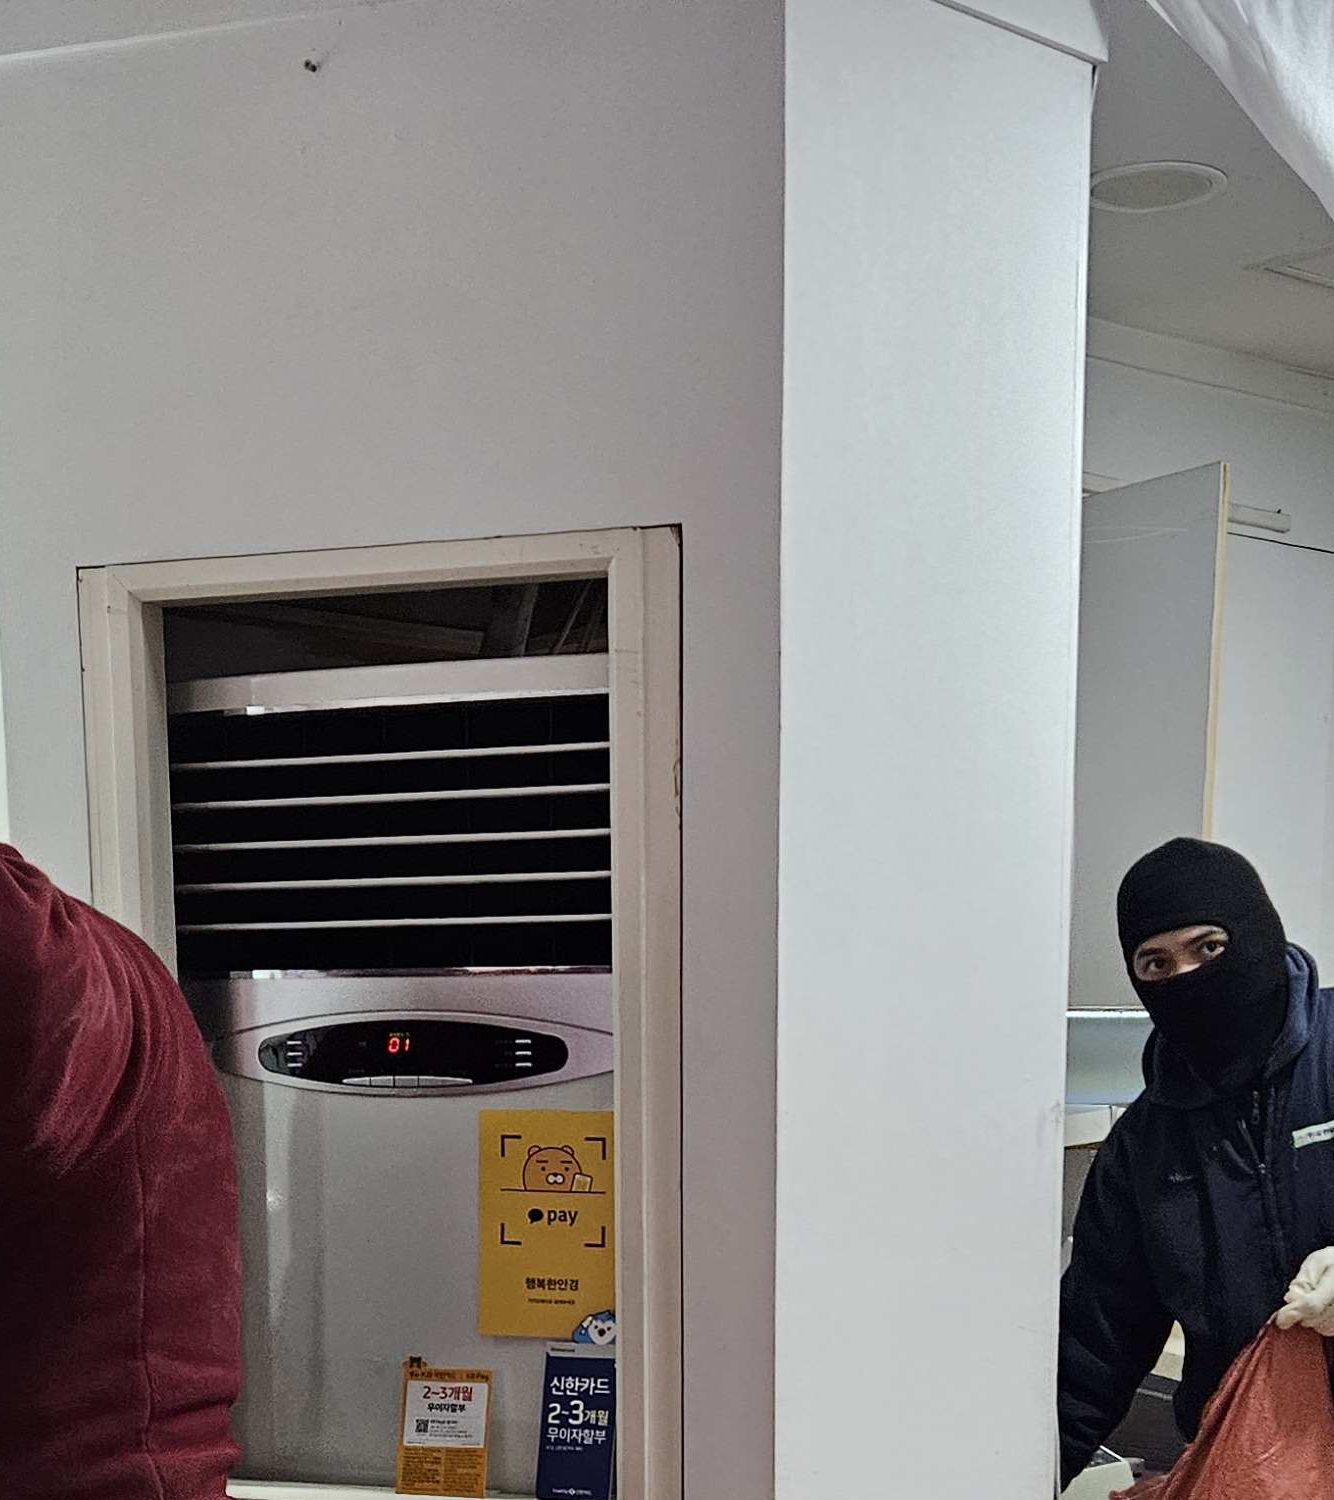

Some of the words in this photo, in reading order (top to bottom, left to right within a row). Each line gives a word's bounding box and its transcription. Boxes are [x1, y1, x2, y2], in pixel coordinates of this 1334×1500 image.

[388, 1037, 410, 1054] 01
[547, 1210, 578, 1227] pay
[550, 1376, 610, 1396] 신한카드
[547, 1400, 609, 1426] 2~3개월
[546, 1427, 607, 1445] 무이자할부
